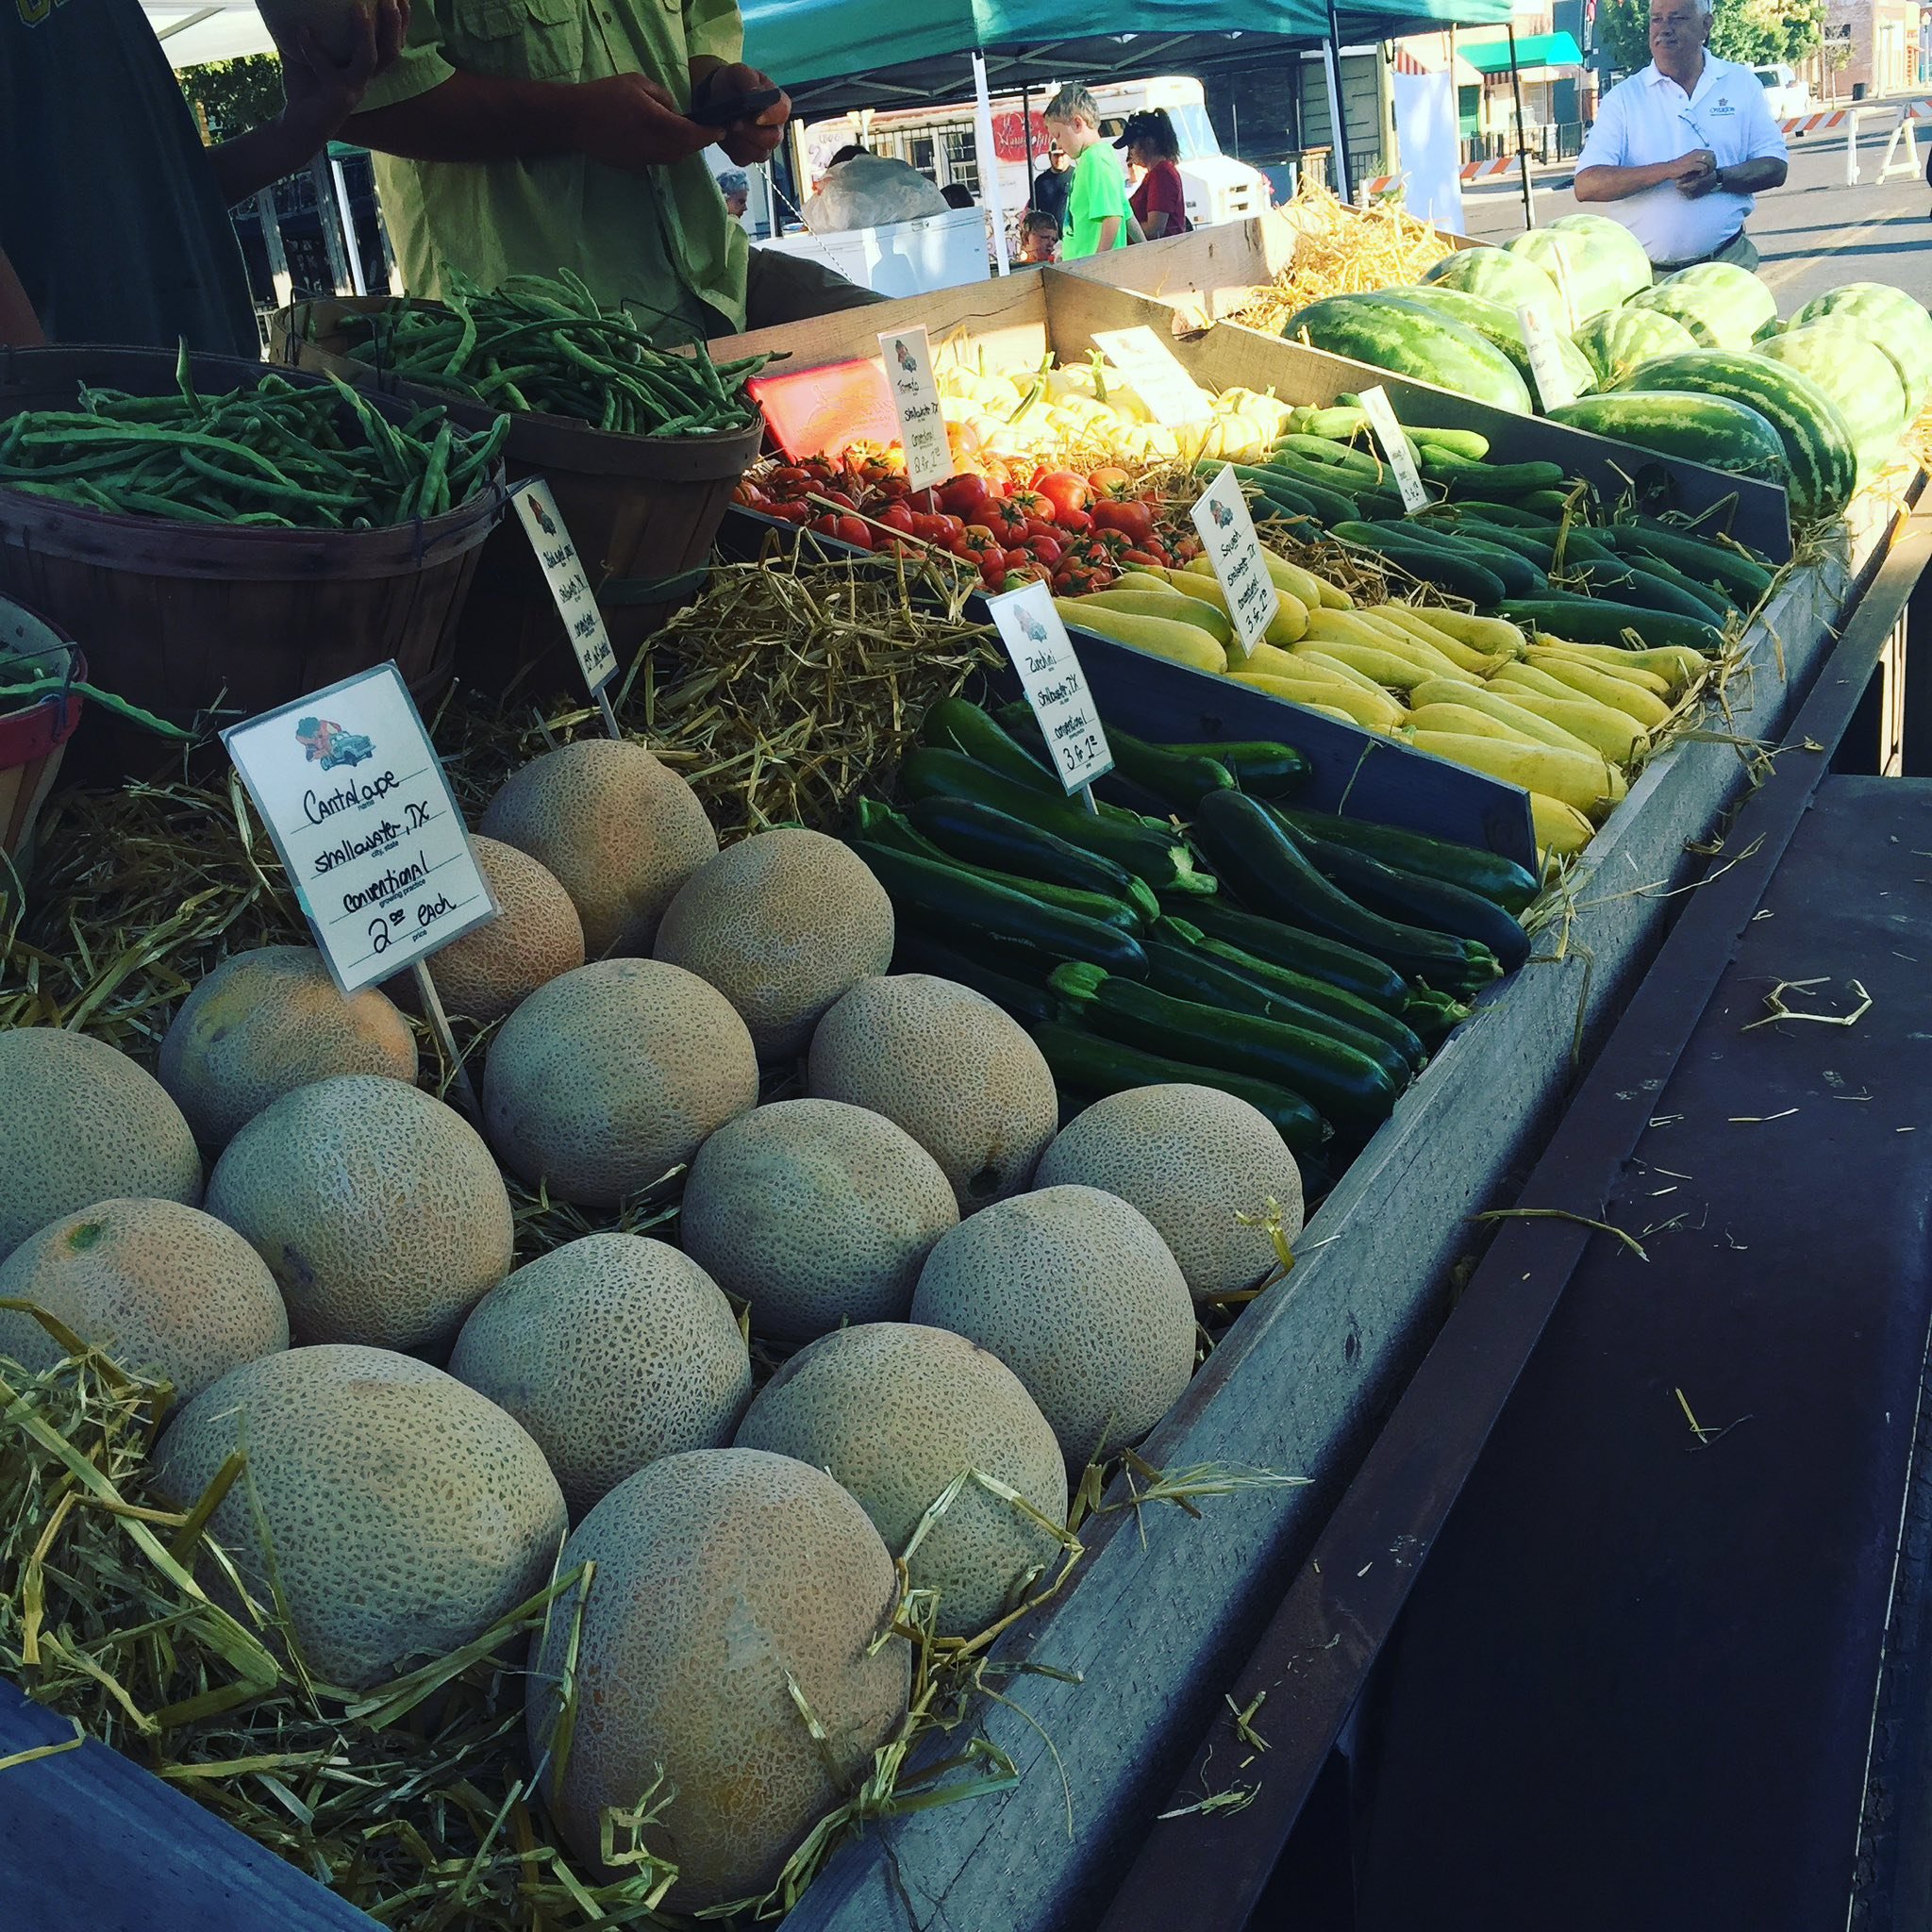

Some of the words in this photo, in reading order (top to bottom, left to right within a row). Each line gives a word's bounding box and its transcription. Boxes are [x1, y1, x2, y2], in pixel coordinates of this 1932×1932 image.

[1246, 615, 1253, 633] 3
[1066, 674, 1079, 693] TX
[1063, 748, 1074, 770] 3
[405, 800, 429, 829] TX
[384, 840, 399, 852] state
[378, 889, 403, 908] growing
[403, 878, 426, 899] practice
[417, 892, 457, 925] each
[412, 929, 427, 941] price
